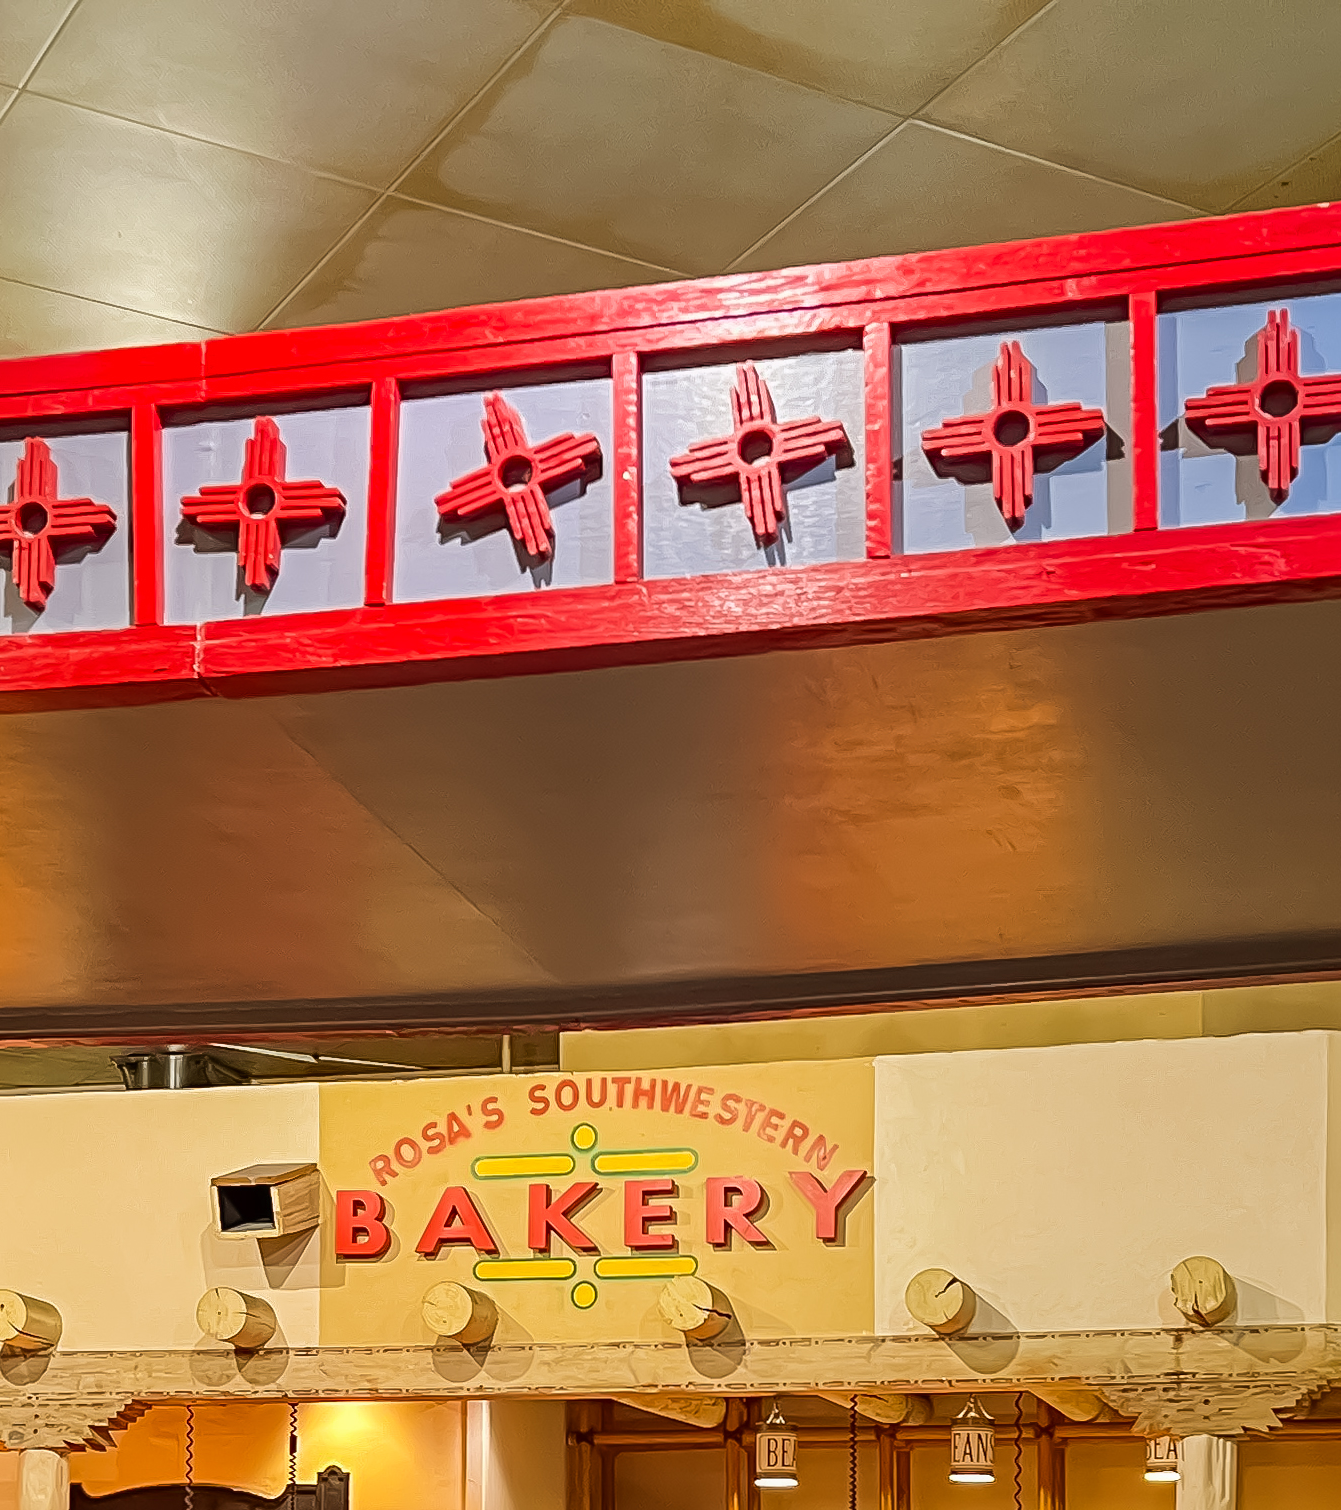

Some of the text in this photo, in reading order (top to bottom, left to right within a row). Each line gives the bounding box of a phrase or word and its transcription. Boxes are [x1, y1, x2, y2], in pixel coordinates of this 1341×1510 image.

[369, 1076, 840, 1187] ROSA'S SOUTHWESTERN
[335, 1169, 870, 1262] BAKERY
